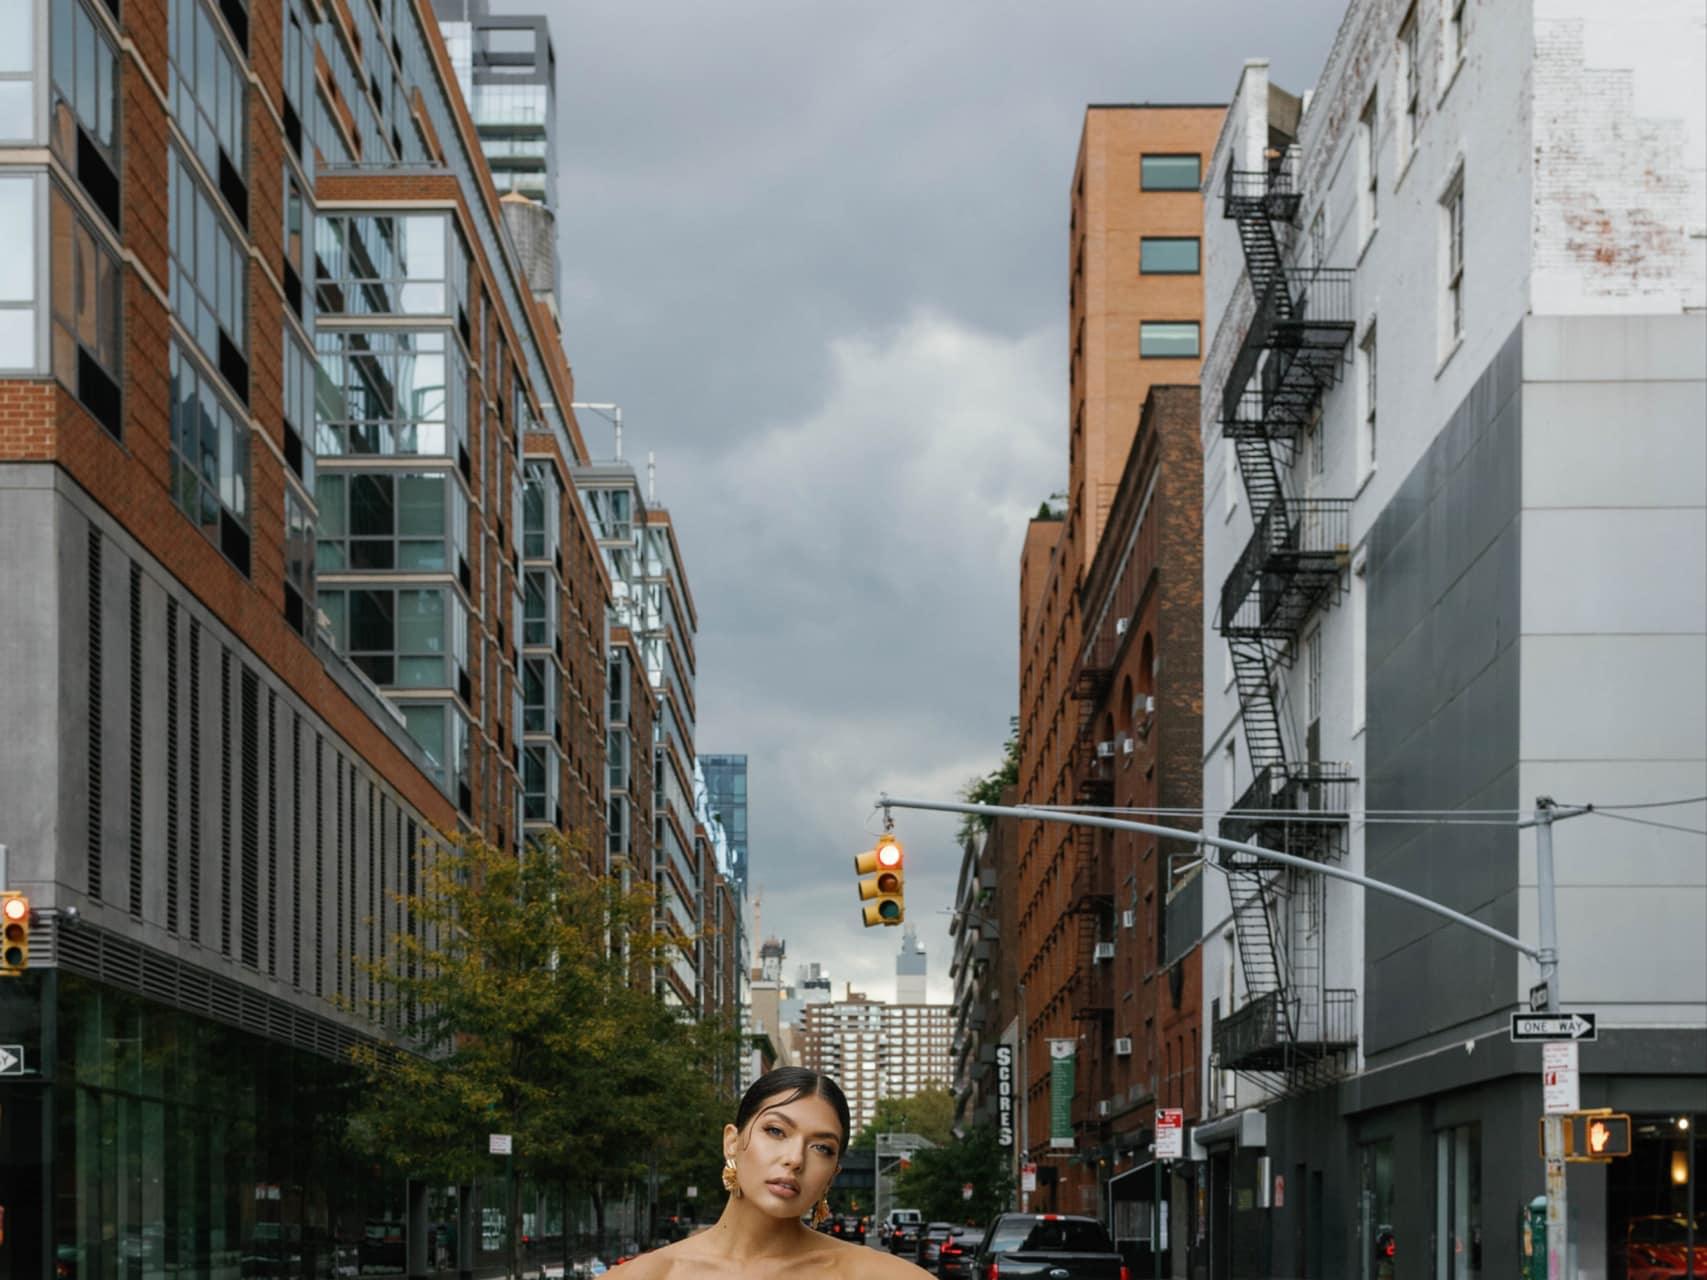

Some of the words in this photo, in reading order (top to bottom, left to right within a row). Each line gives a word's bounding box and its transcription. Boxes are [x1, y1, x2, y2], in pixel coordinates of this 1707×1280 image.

[1524, 1022, 1547, 1033] ONE
[1559, 1022, 1583, 1032] WAY
[996, 1047, 1013, 1146] SCORES
